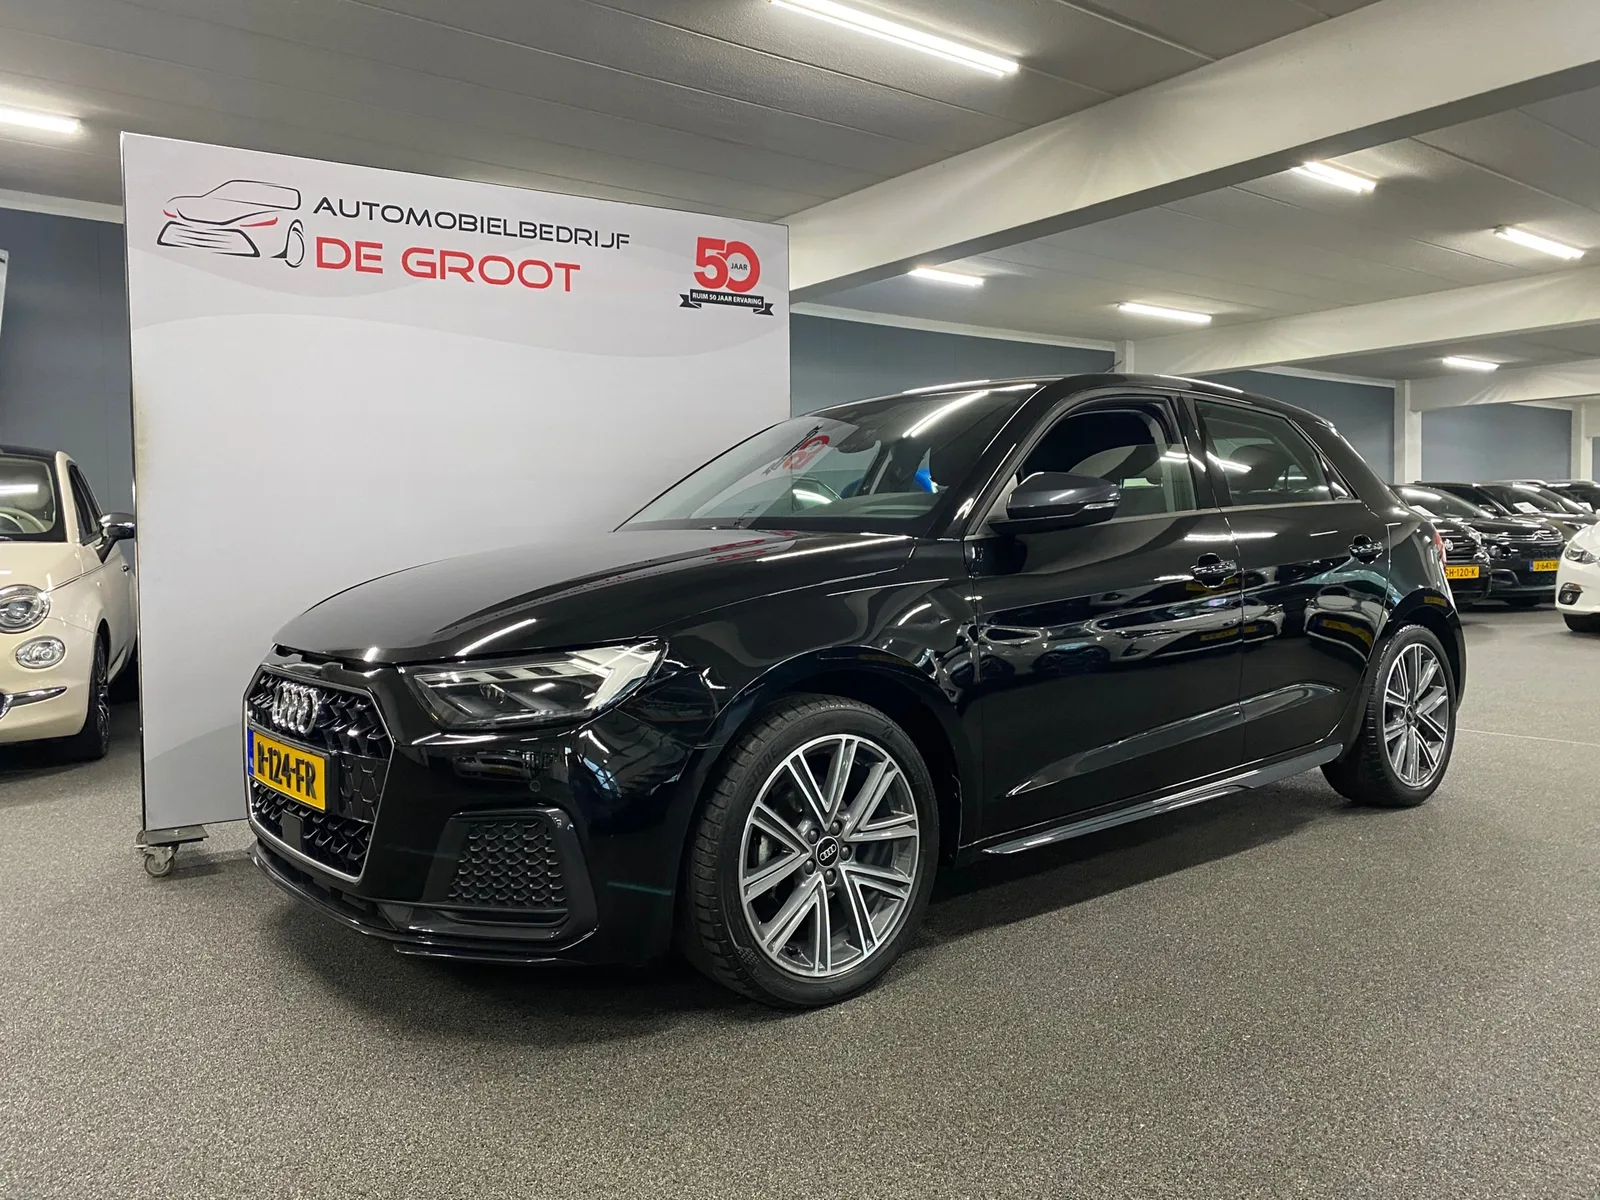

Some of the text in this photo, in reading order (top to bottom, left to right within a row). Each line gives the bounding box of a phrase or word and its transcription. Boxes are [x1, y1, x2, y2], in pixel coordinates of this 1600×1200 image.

[313, 196, 630, 250] AUTOMOBIELBEDRIJF
[316, 236, 581, 292] DE GROOT
[693, 236, 760, 293] 50
[730, 262, 748, 271] JAAR
[692, 292, 709, 300] RUIM
[717, 295, 733, 303] JAAR
[733, 296, 762, 305] ERVARING
